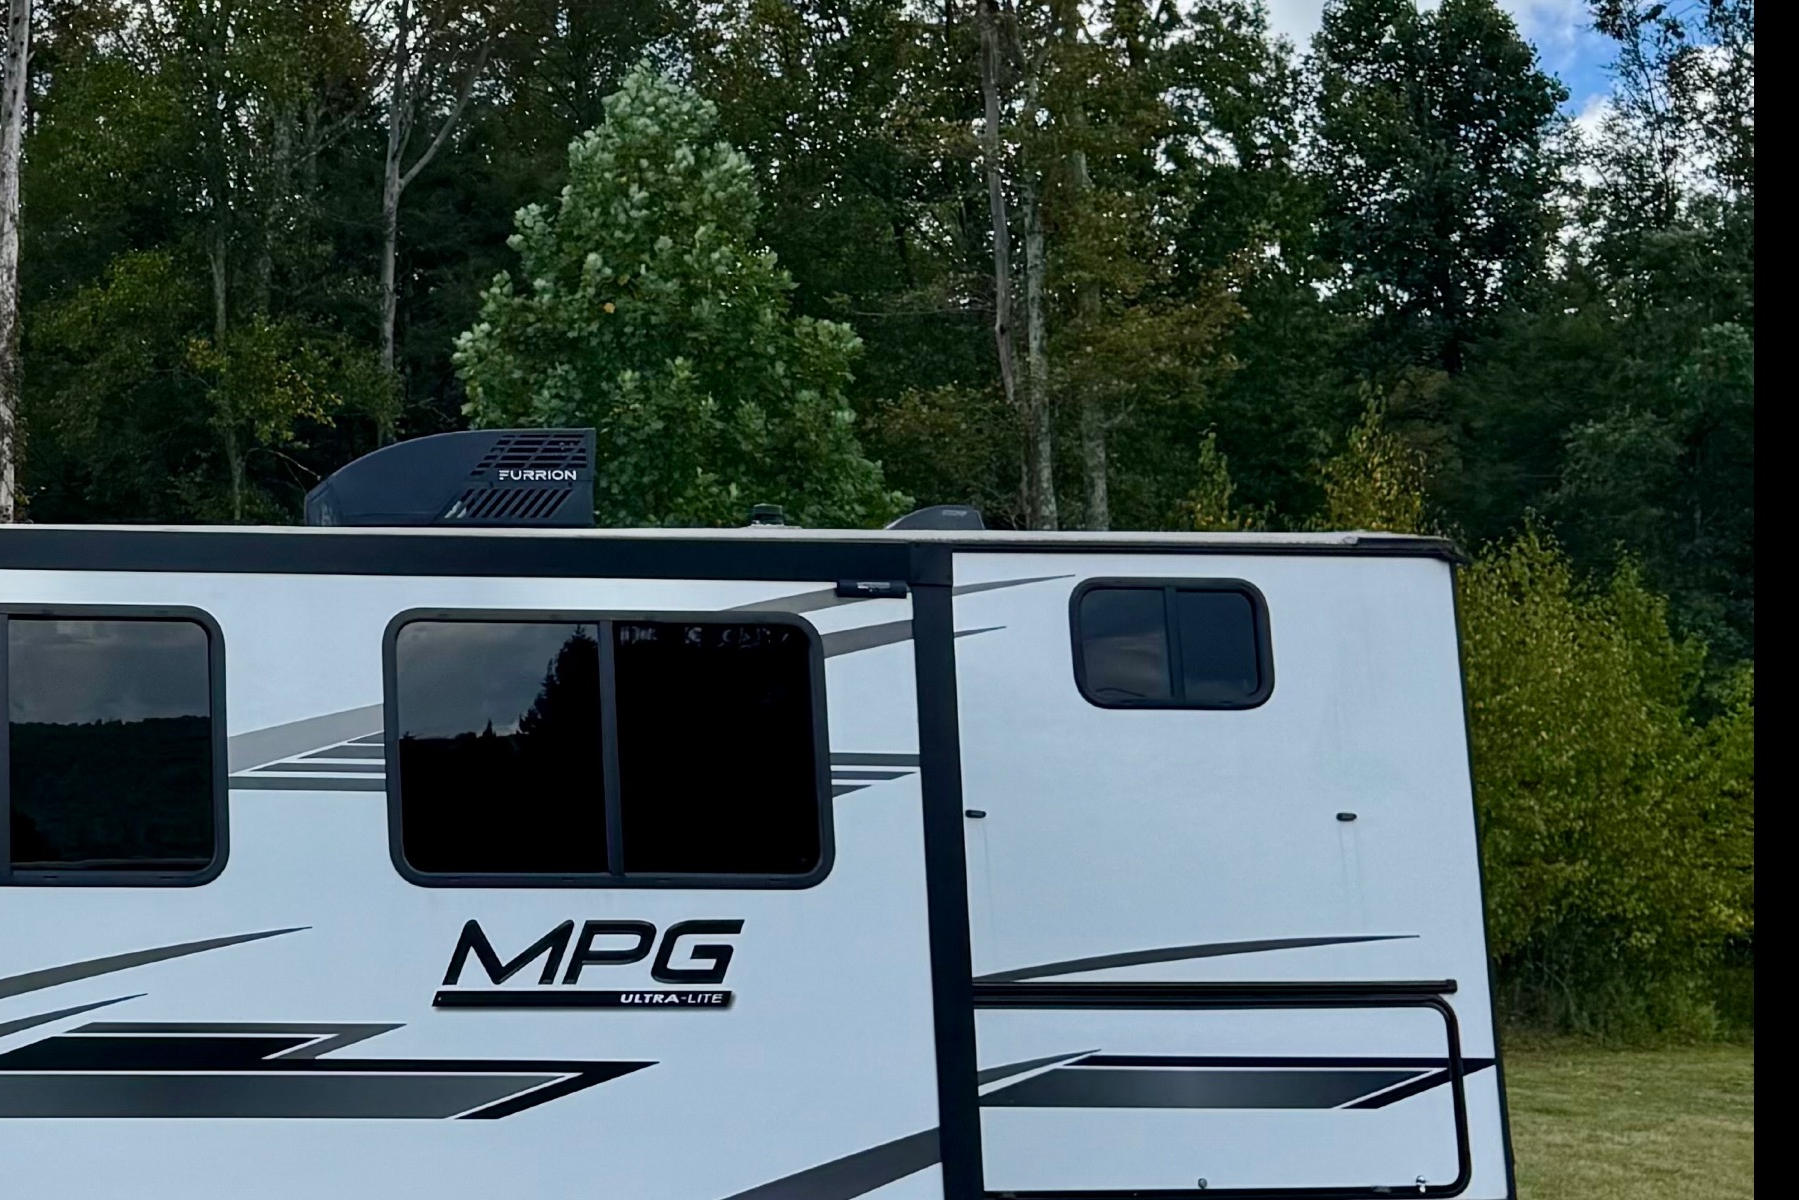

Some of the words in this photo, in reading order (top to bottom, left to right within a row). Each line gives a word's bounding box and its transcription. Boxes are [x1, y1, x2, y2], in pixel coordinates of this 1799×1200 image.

[498, 469, 577, 481] FURRION
[441, 918, 746, 986] MPG
[619, 992, 724, 1004] ULTRA-LITE
